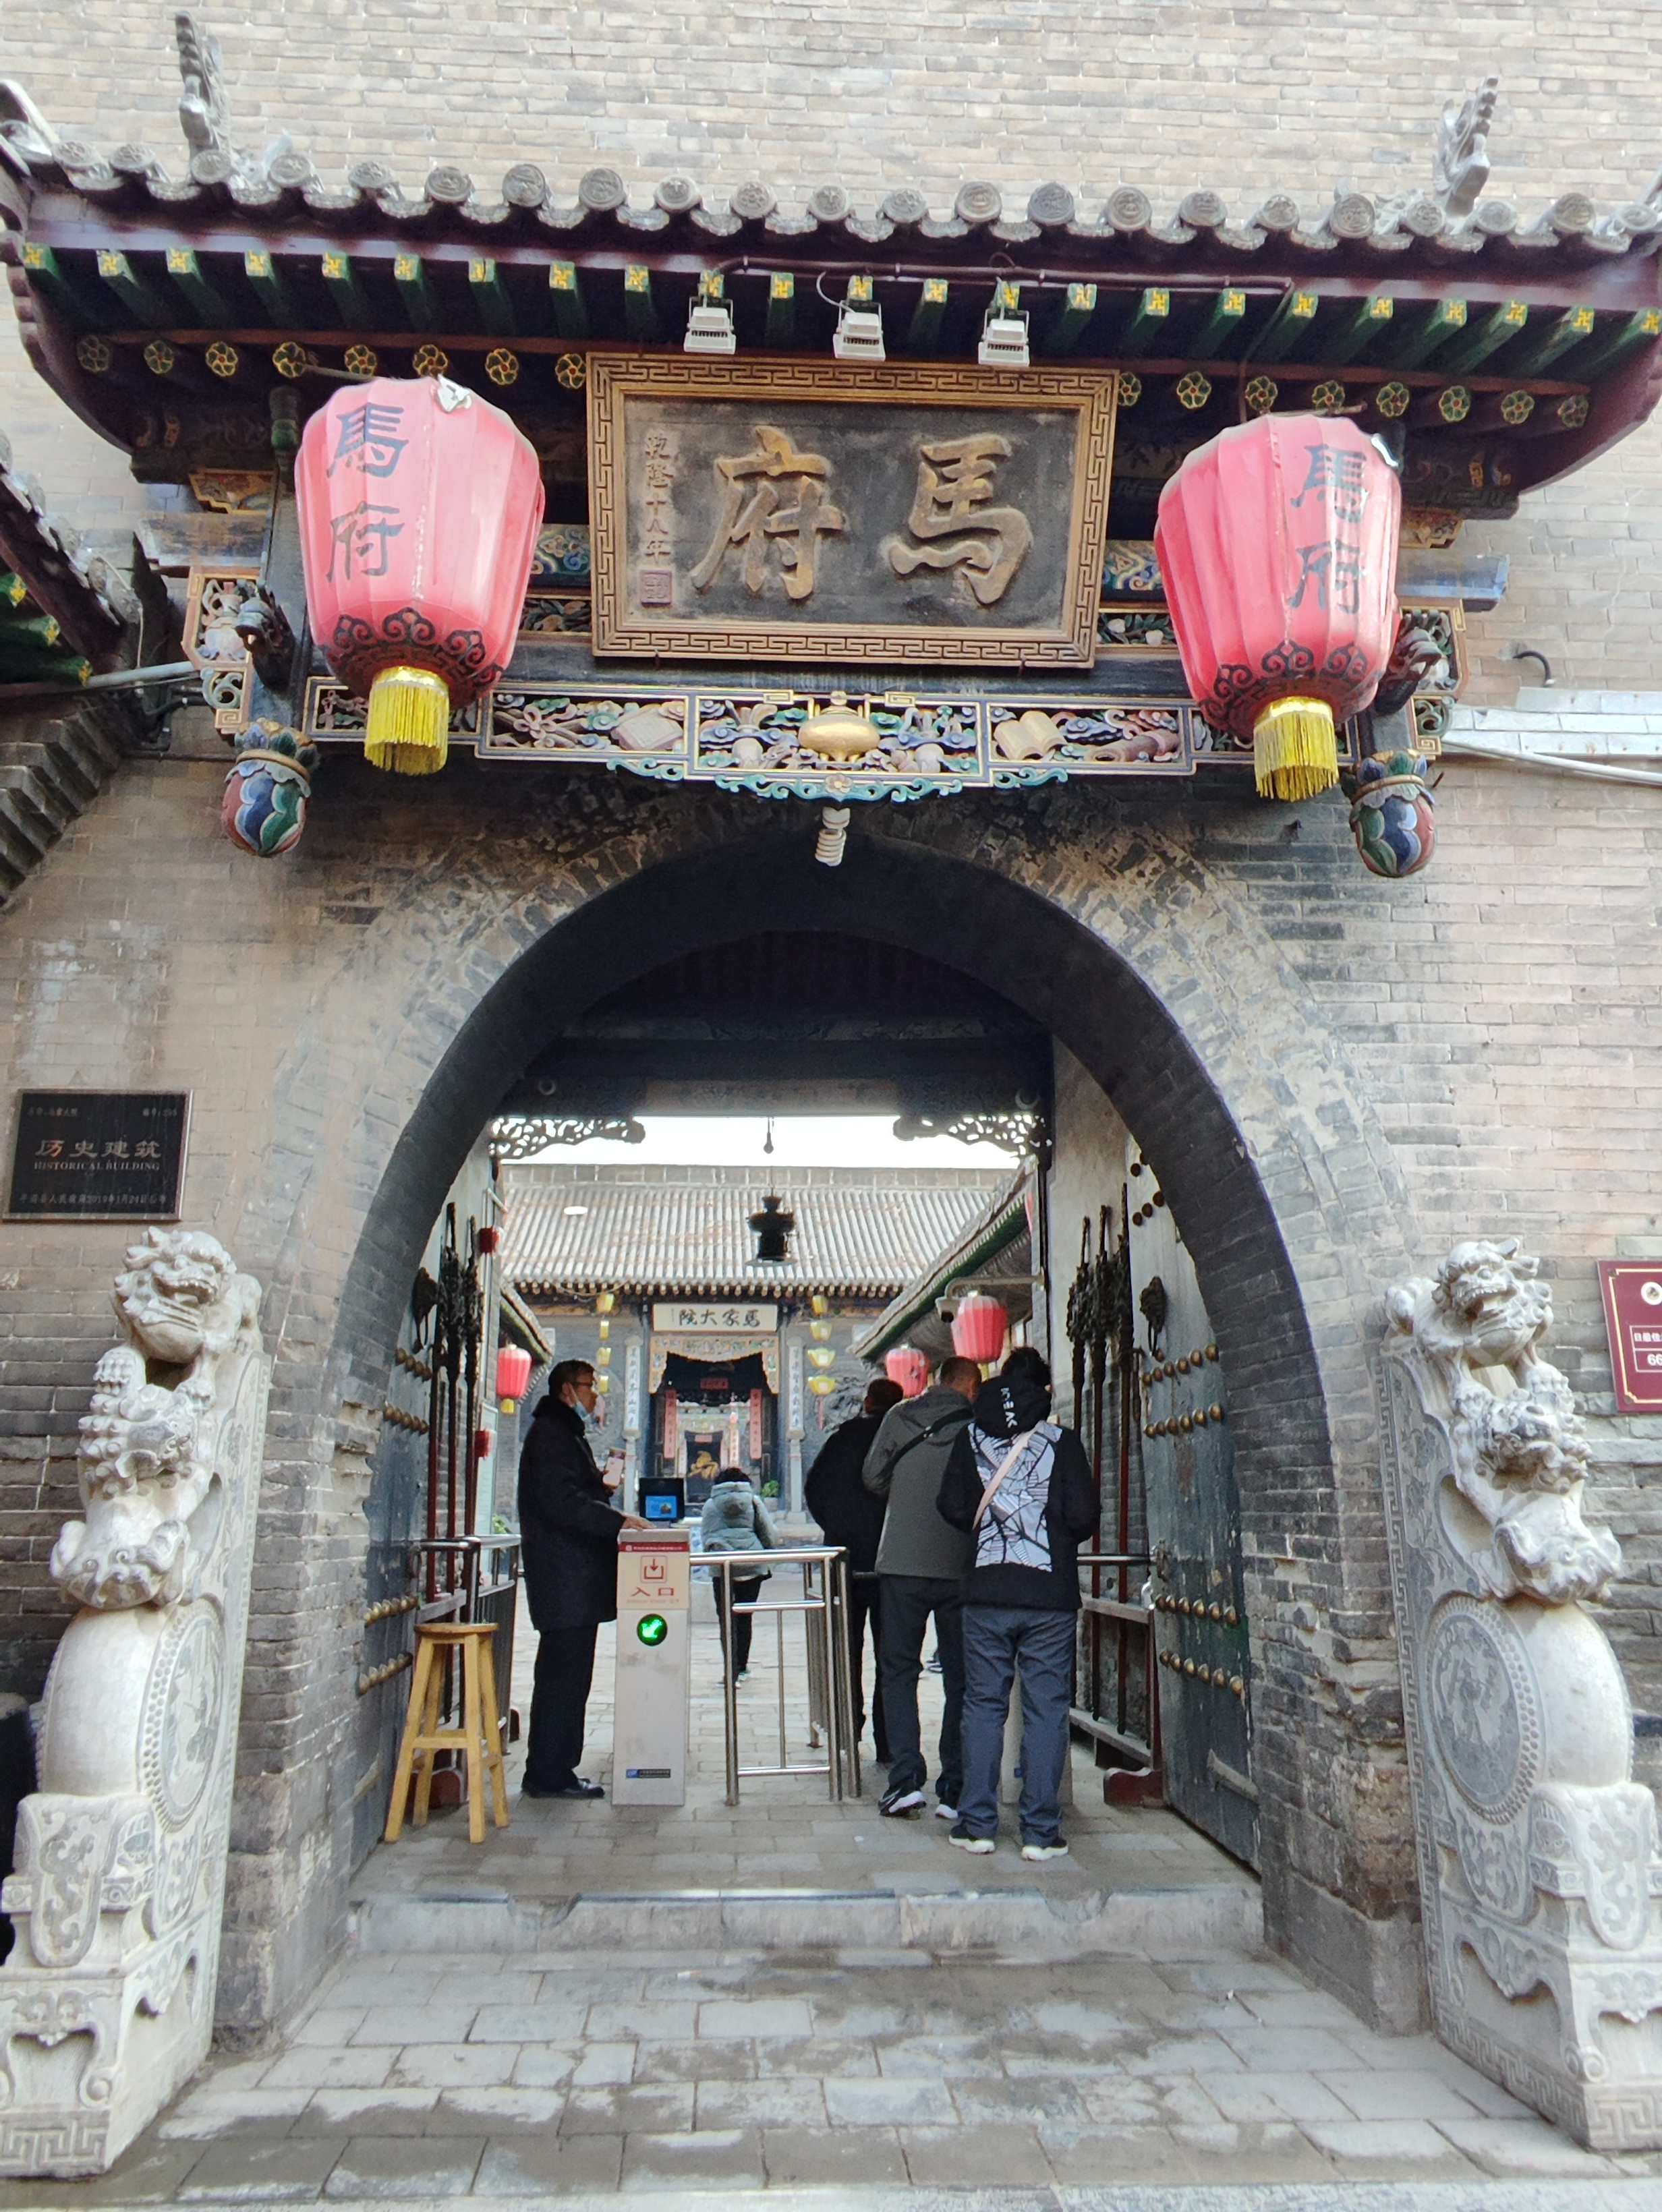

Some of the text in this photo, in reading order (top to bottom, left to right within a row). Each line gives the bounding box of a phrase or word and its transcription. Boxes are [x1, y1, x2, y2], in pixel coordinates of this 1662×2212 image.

[326, 401, 409, 583] 馬府
[35, 1140, 162, 1159] 历史建筑
[34, 1161, 160, 1171] HISTORICAL BUILDING
[631, 1586, 675, 1596] 入口
